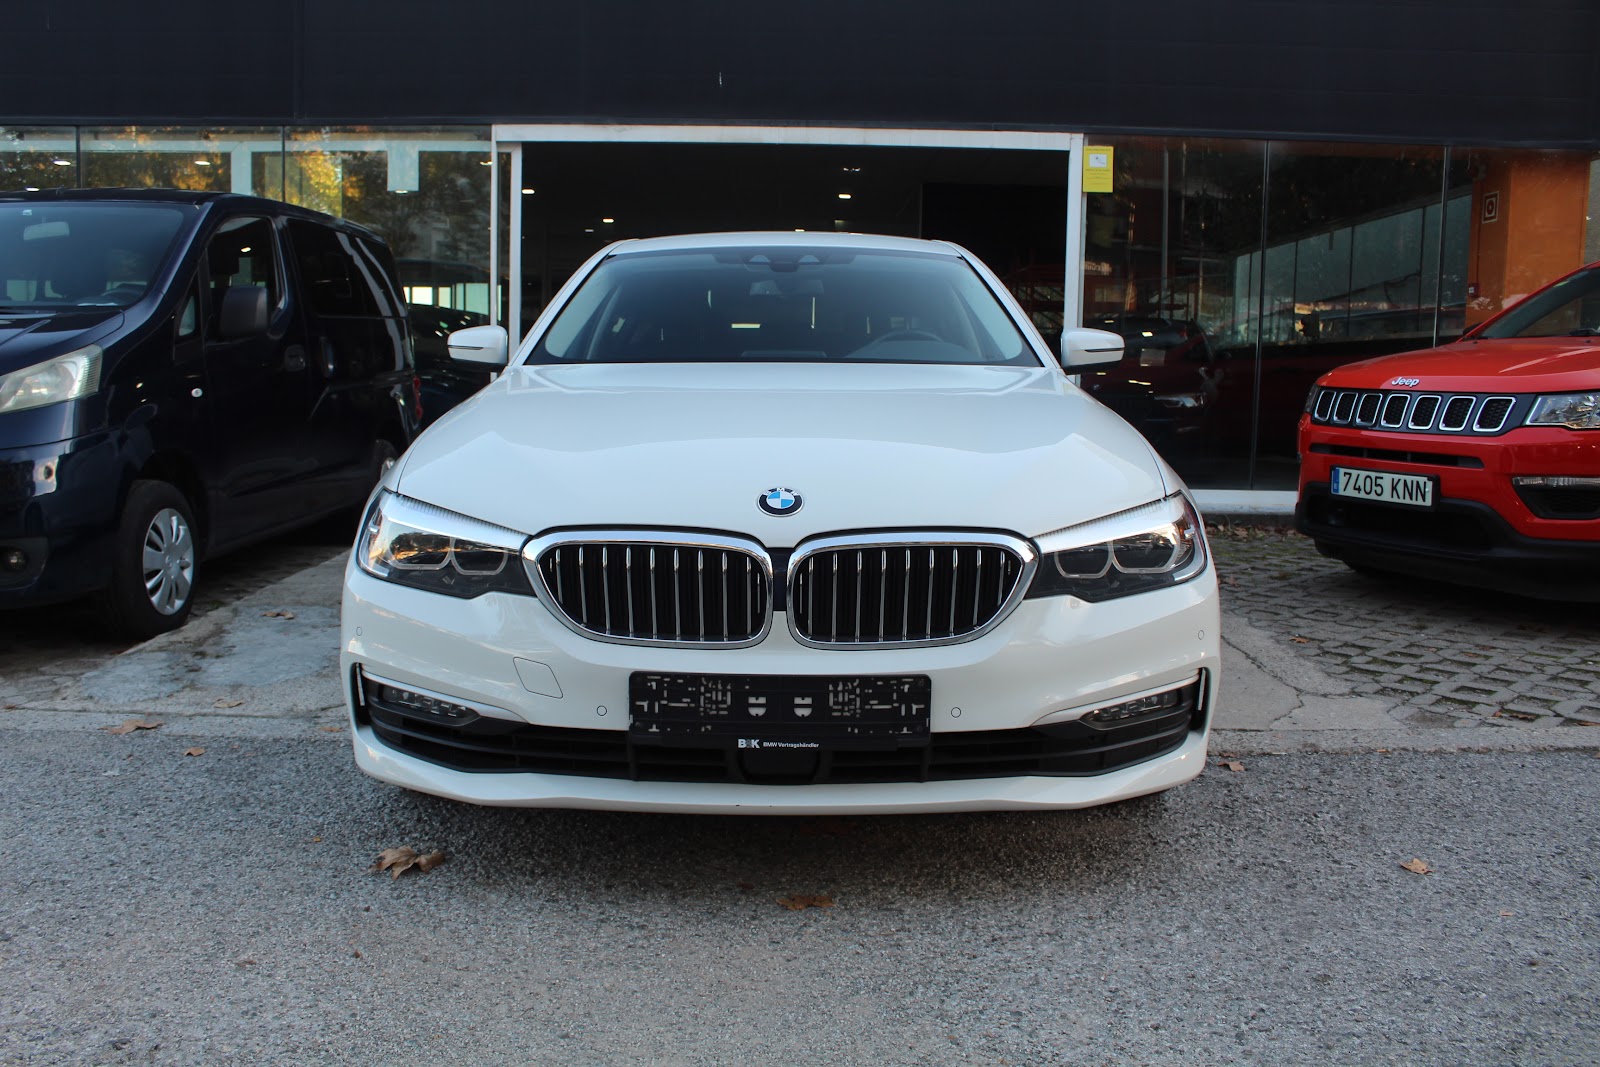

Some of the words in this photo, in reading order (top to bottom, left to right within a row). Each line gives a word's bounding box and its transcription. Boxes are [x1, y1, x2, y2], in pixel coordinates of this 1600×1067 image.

[1391, 377, 1420, 387] Jeep
[1343, 472, 1384, 496] 7405
[1391, 478, 1426, 502] KNN
